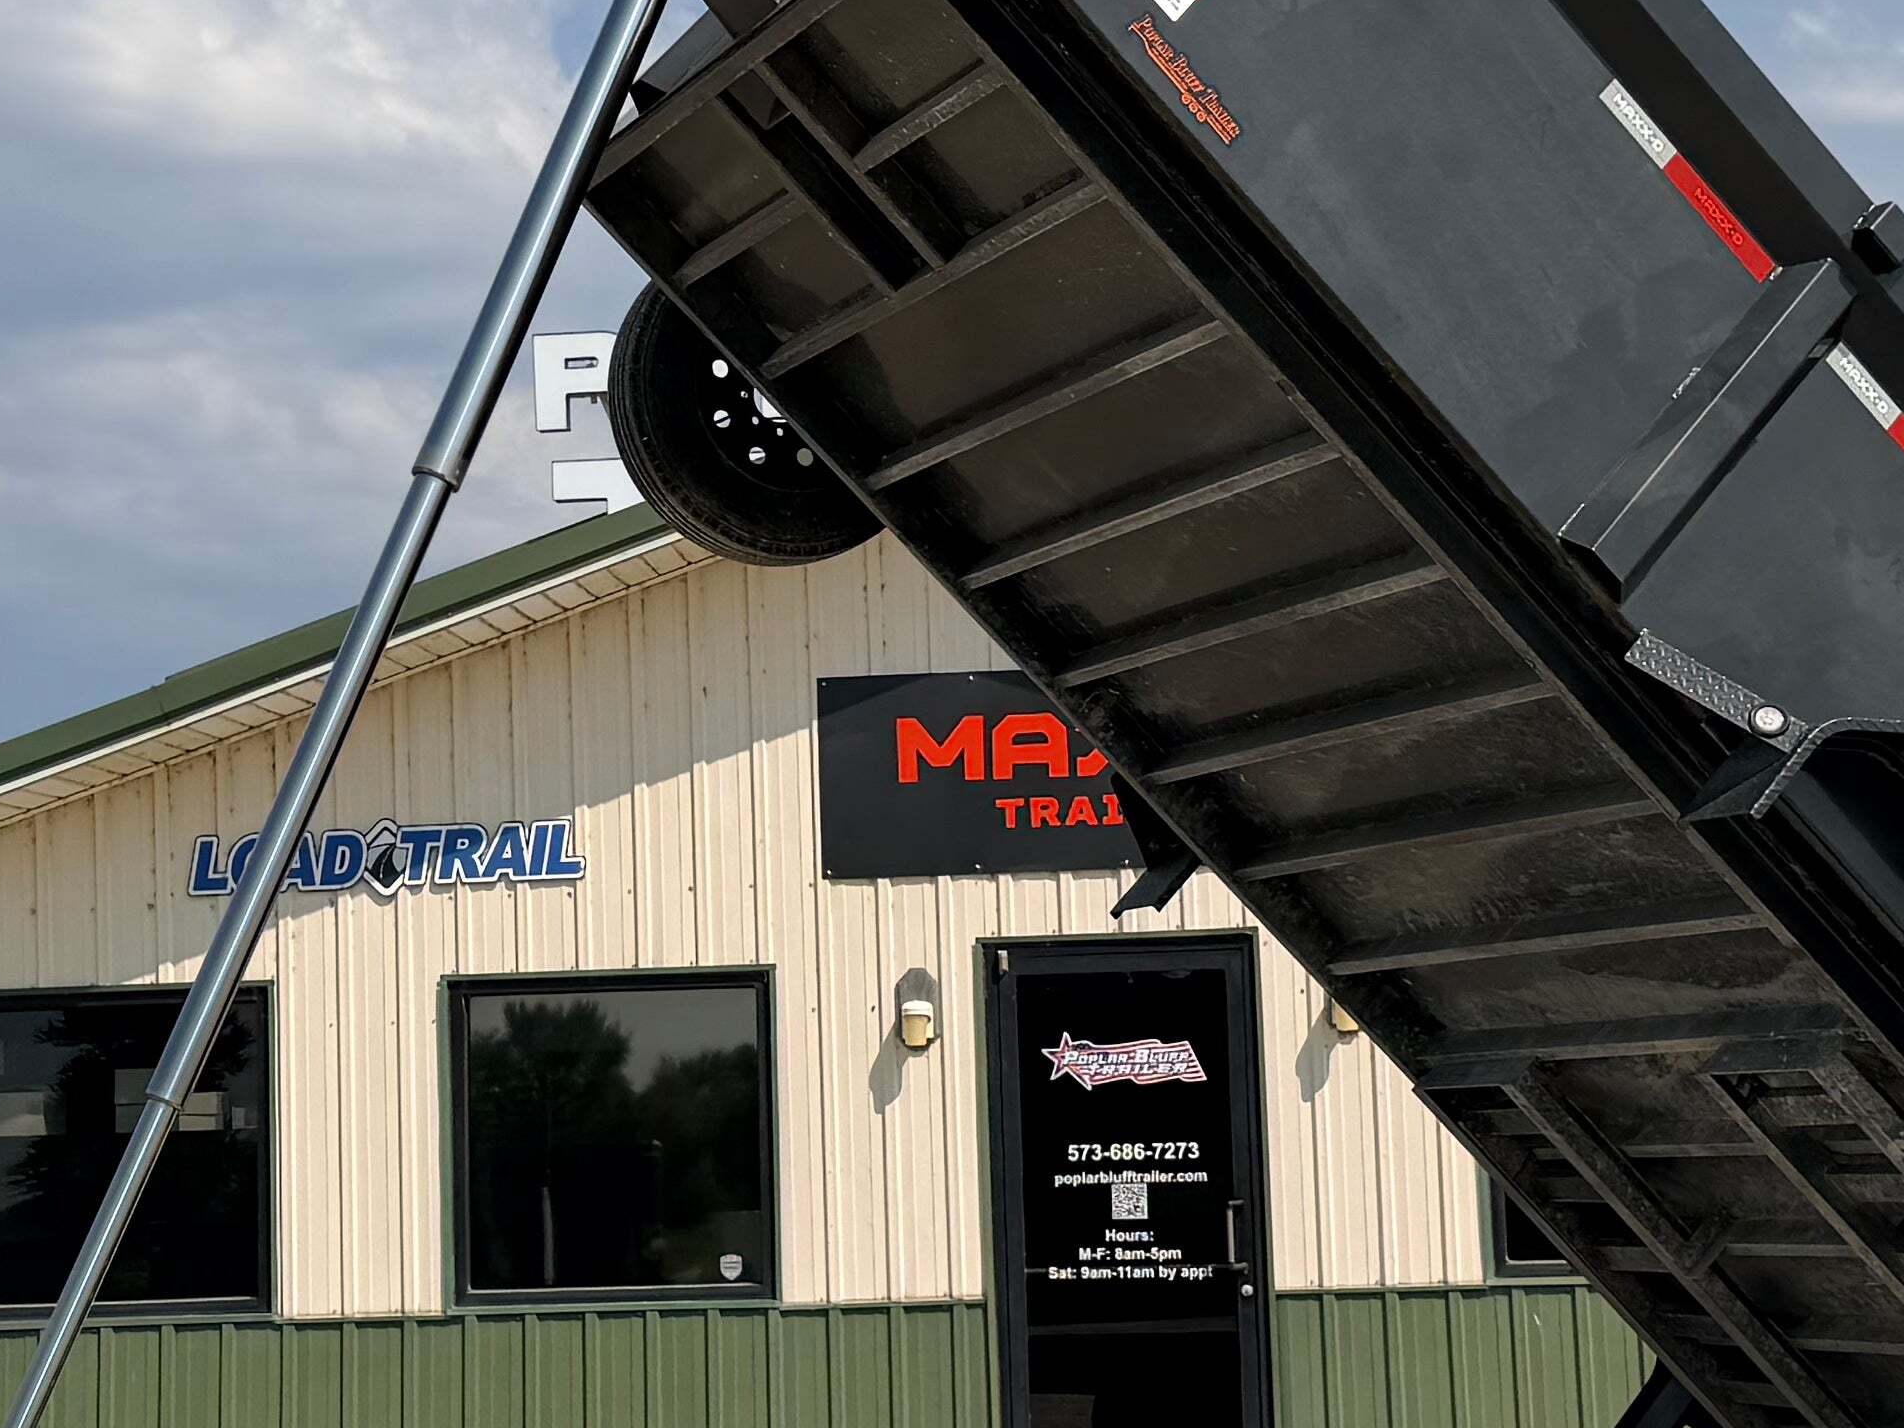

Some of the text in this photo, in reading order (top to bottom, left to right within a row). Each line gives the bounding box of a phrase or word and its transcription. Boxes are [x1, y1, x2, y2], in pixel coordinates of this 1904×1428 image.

[1612, 92, 1665, 153] MAXX-D
[1694, 187, 1744, 246] MAXX-D
[1839, 356, 1889, 415] MAXX-D
[896, 712, 1109, 782] MA
[399, 820, 585, 885] TRAIL
[1067, 1142, 1200, 1161] 573-686-7273
[1054, 1171, 1208, 1187] poplarblufftrailer.com
[1079, 1247, 1182, 1262] M-F: 8am-5pm
[1105, 1229, 1154, 1242] Hours:
[1049, 1266, 1077, 1279] Sat:
[1080, 1265, 1155, 1280] 9am-11am
[1158, 1265, 1177, 1281] by
